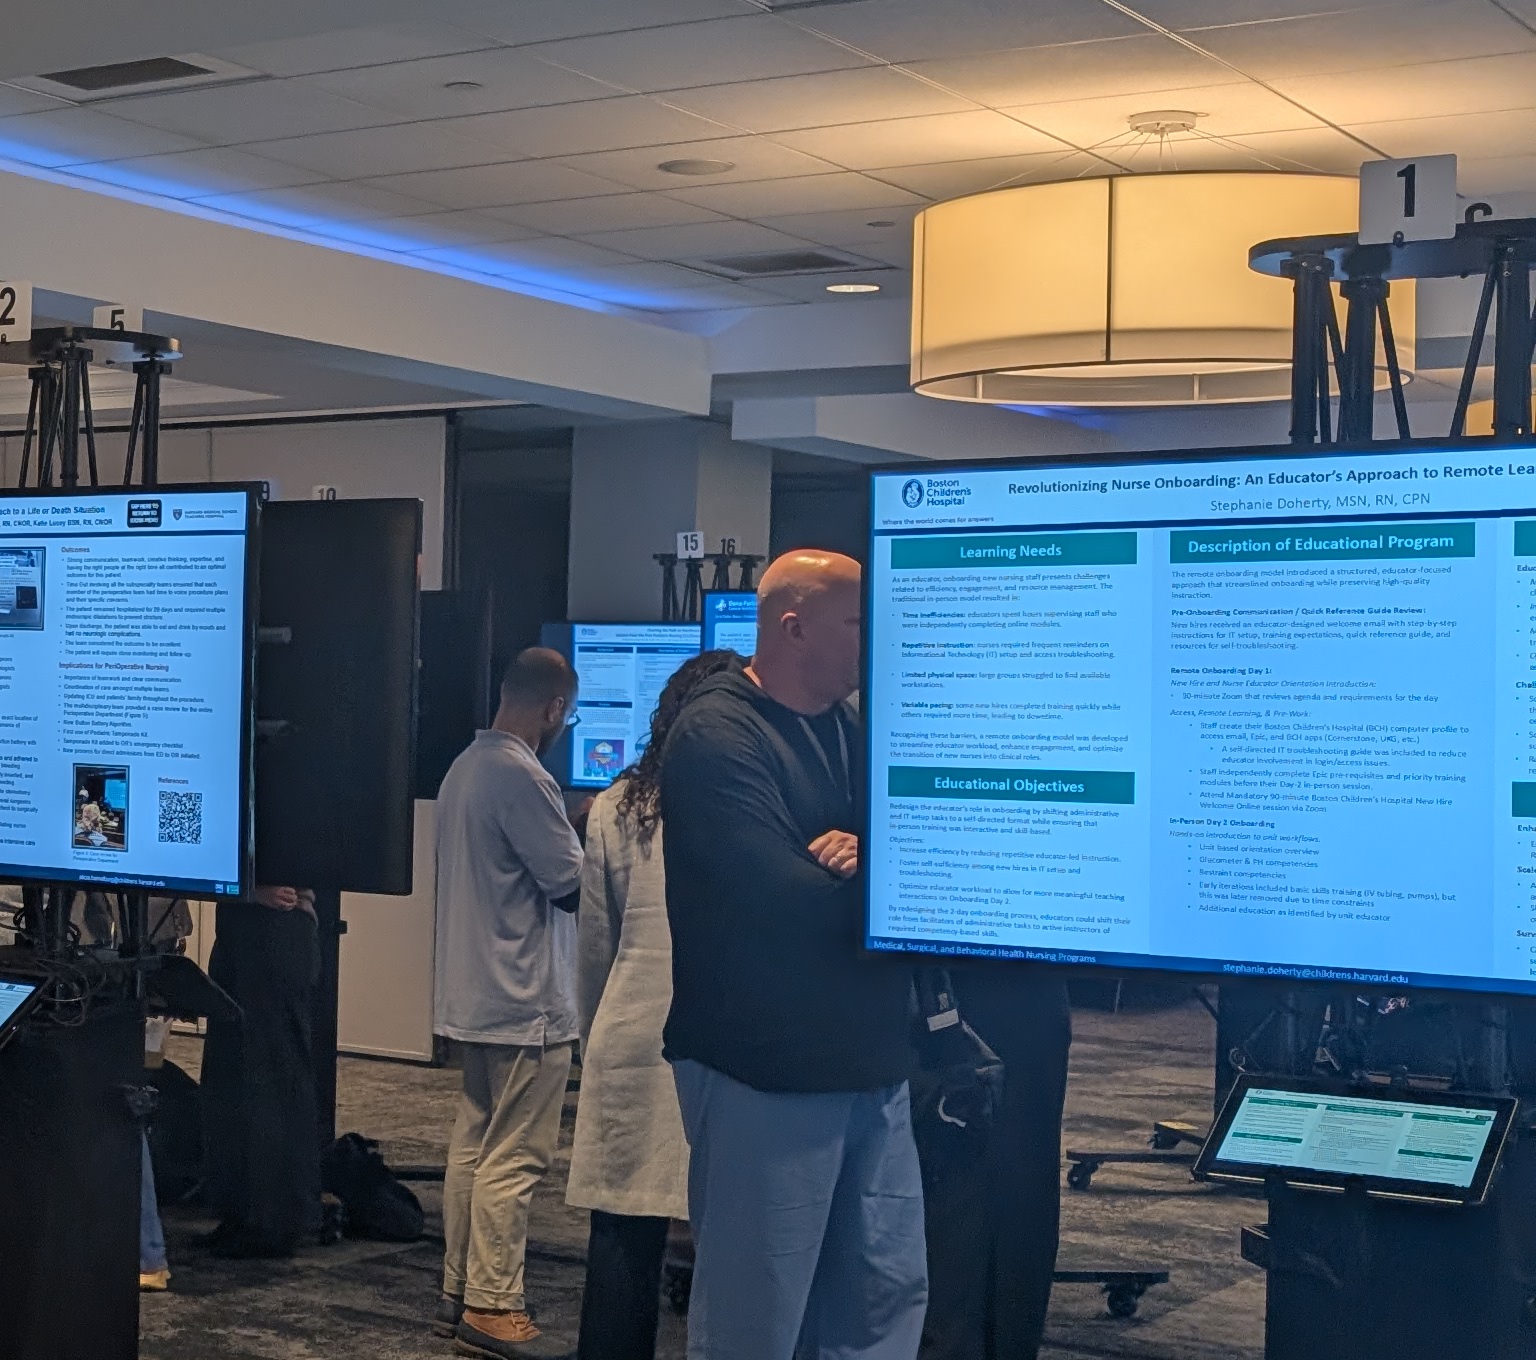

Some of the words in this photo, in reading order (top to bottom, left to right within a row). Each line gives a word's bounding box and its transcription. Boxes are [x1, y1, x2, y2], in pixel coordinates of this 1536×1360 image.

[1397, 164, 1415, 217] 1
[110, 309, 125, 331] 5
[927, 479, 960, 488] Boston
[1008, 479, 1107, 494] Revolutionizing
[1111, 478, 1150, 490] Nurse
[1154, 474, 1240, 490] Onboarding:
[1244, 473, 1263, 485] An
[1268, 470, 1342, 484] Educator's
[1346, 468, 1418, 481] Approach
[1423, 467, 1438, 478] to
[1443, 464, 1503, 478] Remote
[927, 487, 972, 497] Children's
[926, 496, 965, 507] Hospital
[1210, 498, 1272, 511] Stephanie
[1277, 496, 1331, 509] Doherty,
[1336, 495, 1370, 507] MSN,
[1375, 494, 1397, 506] RN,
[1402, 492, 1430, 504] CPN
[50, 506, 71, 514] Death
[73, 506, 105, 514] Situation
[683, 534, 698, 551] 15
[721, 538, 736, 554] 16
[1188, 539, 1270, 552] Description
[1275, 537, 1290, 550] of
[1294, 535, 1383, 550] Educational
[1388, 534, 1454, 550] Program
[960, 545, 1016, 560] Learning
[1019, 544, 1062, 556] Needs
[1171, 570, 1185, 578] The
[1215, 569, 1258, 578] onboarding
[1301, 607, 1323, 615] Quick
[1363, 619, 1385, 627] email
[145, 663, 169, 672] Nursing
[1201, 667, 1246, 675] Onboarding
[1248, 667, 1263, 675] Day
[934, 776, 1010, 790] Educational
[1013, 778, 1084, 793] Objectives
[873, 940, 905, 950] Medical,
[906, 942, 938, 953] Surgical,
[939, 945, 954, 953] and
[956, 946, 997, 956] Behavioral
[997, 949, 1025, 958] Health
[1025, 951, 1057, 961] Nursing
[1058, 953, 1096, 963] Programs
[1222, 963, 1409, 983] stephanie.doherty@childrens.harvard.edu
